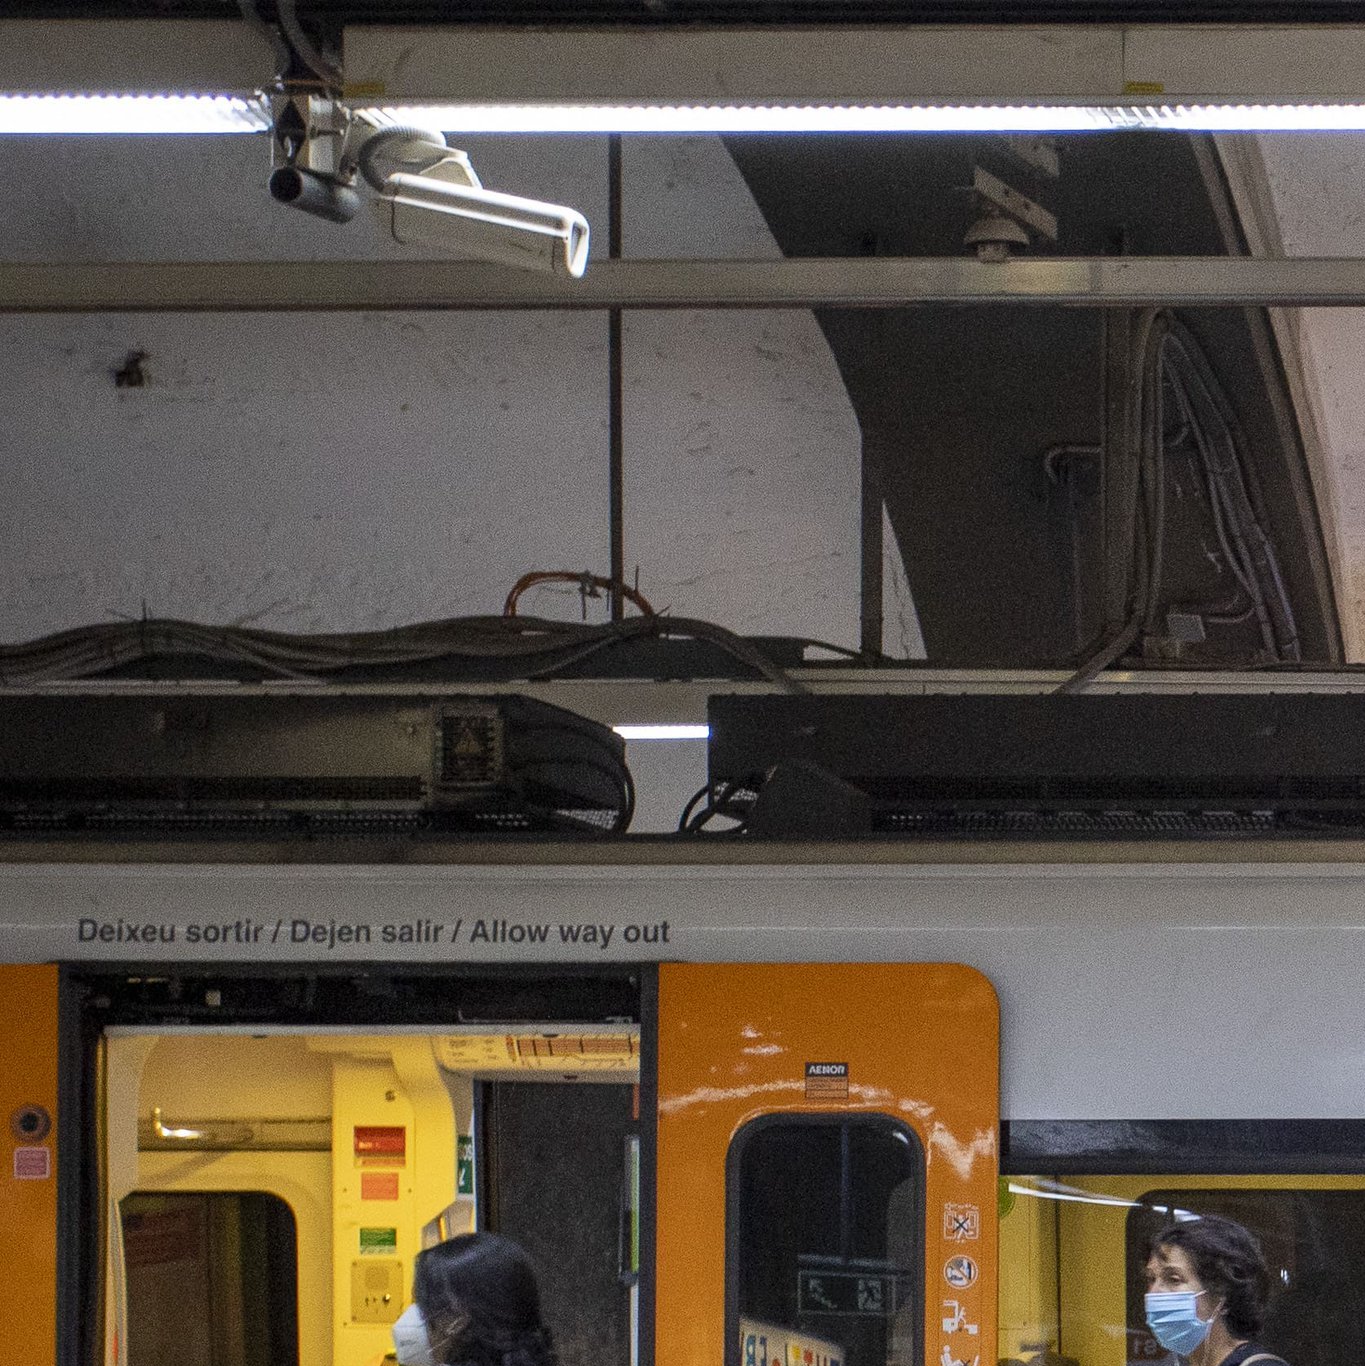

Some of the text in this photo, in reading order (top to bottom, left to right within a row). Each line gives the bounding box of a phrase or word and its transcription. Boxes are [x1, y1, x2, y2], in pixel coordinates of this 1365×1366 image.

[78, 918, 670, 950] Deixeu sortir / Dejen salir / Allow way out
[809, 1065, 845, 1074] AENOR
